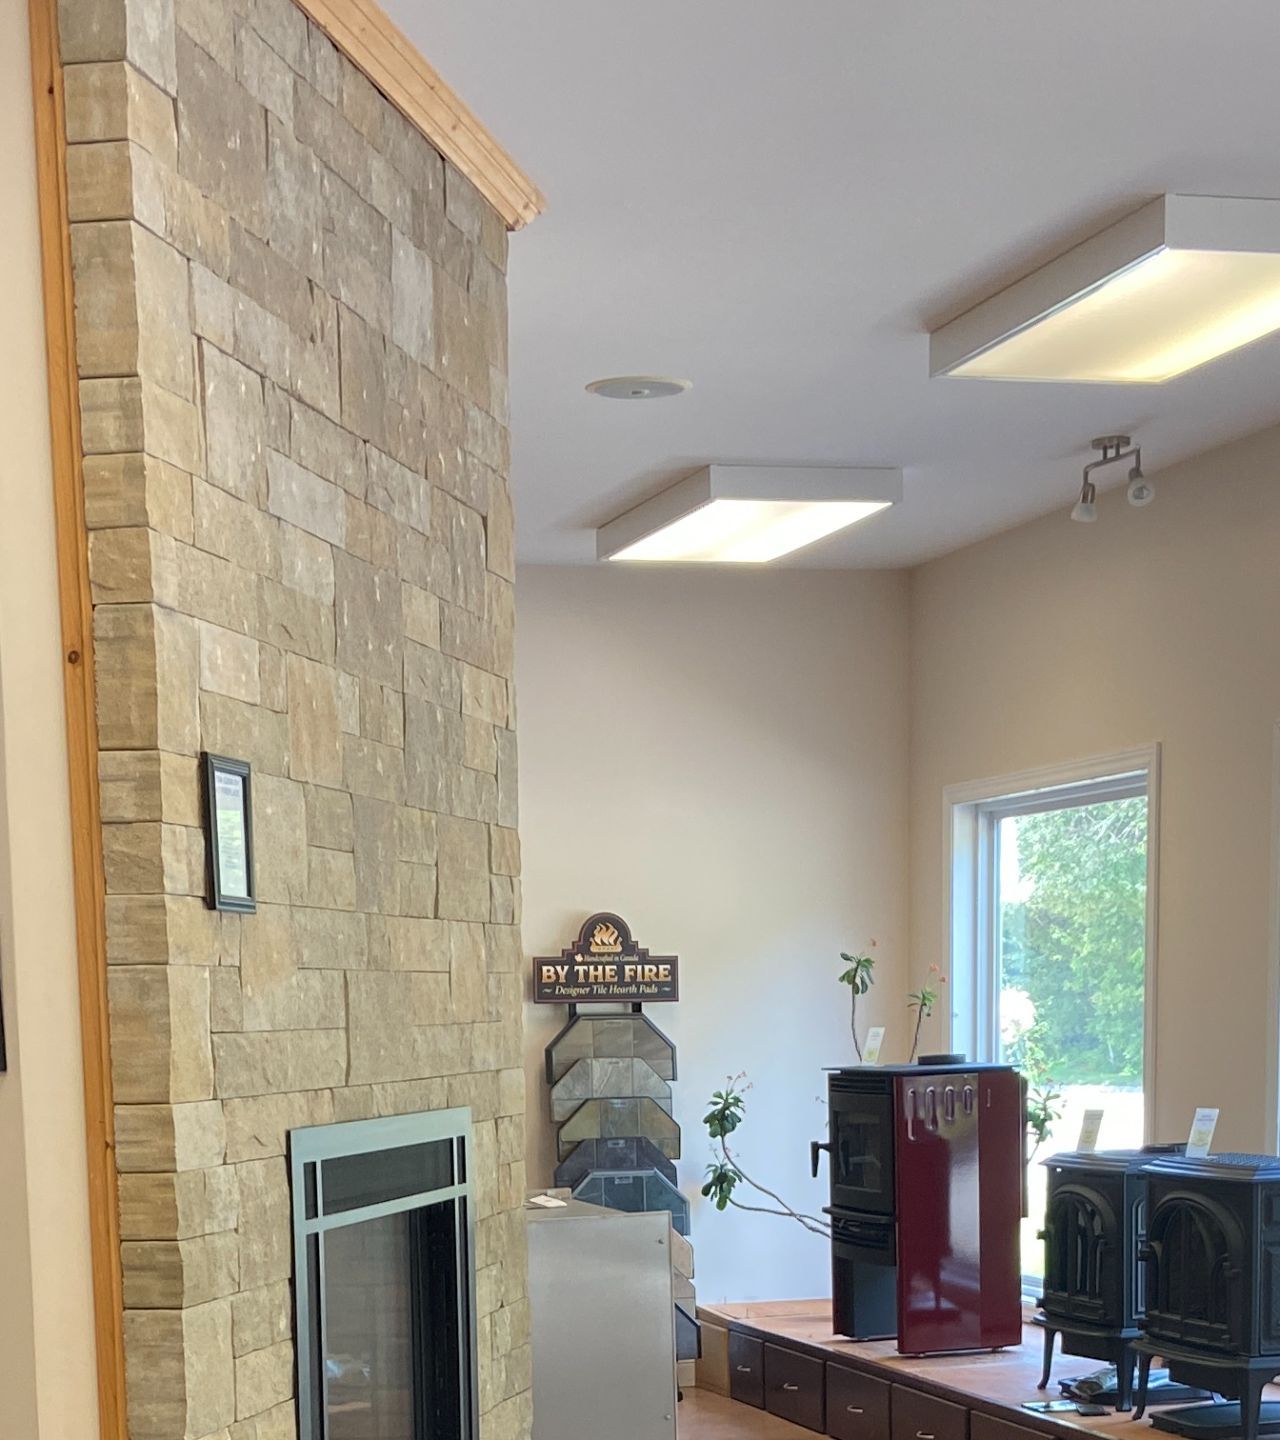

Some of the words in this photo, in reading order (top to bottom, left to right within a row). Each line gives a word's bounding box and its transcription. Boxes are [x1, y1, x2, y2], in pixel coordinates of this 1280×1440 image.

[541, 964, 569, 983] BY
[574, 964, 618, 983] THE
[624, 964, 671, 982] FIRE
[554, 985, 590, 997] Designer
[592, 985, 608, 994] Tile
[609, 985, 637, 995] Hearth
[639, 985, 658, 994] Pads
